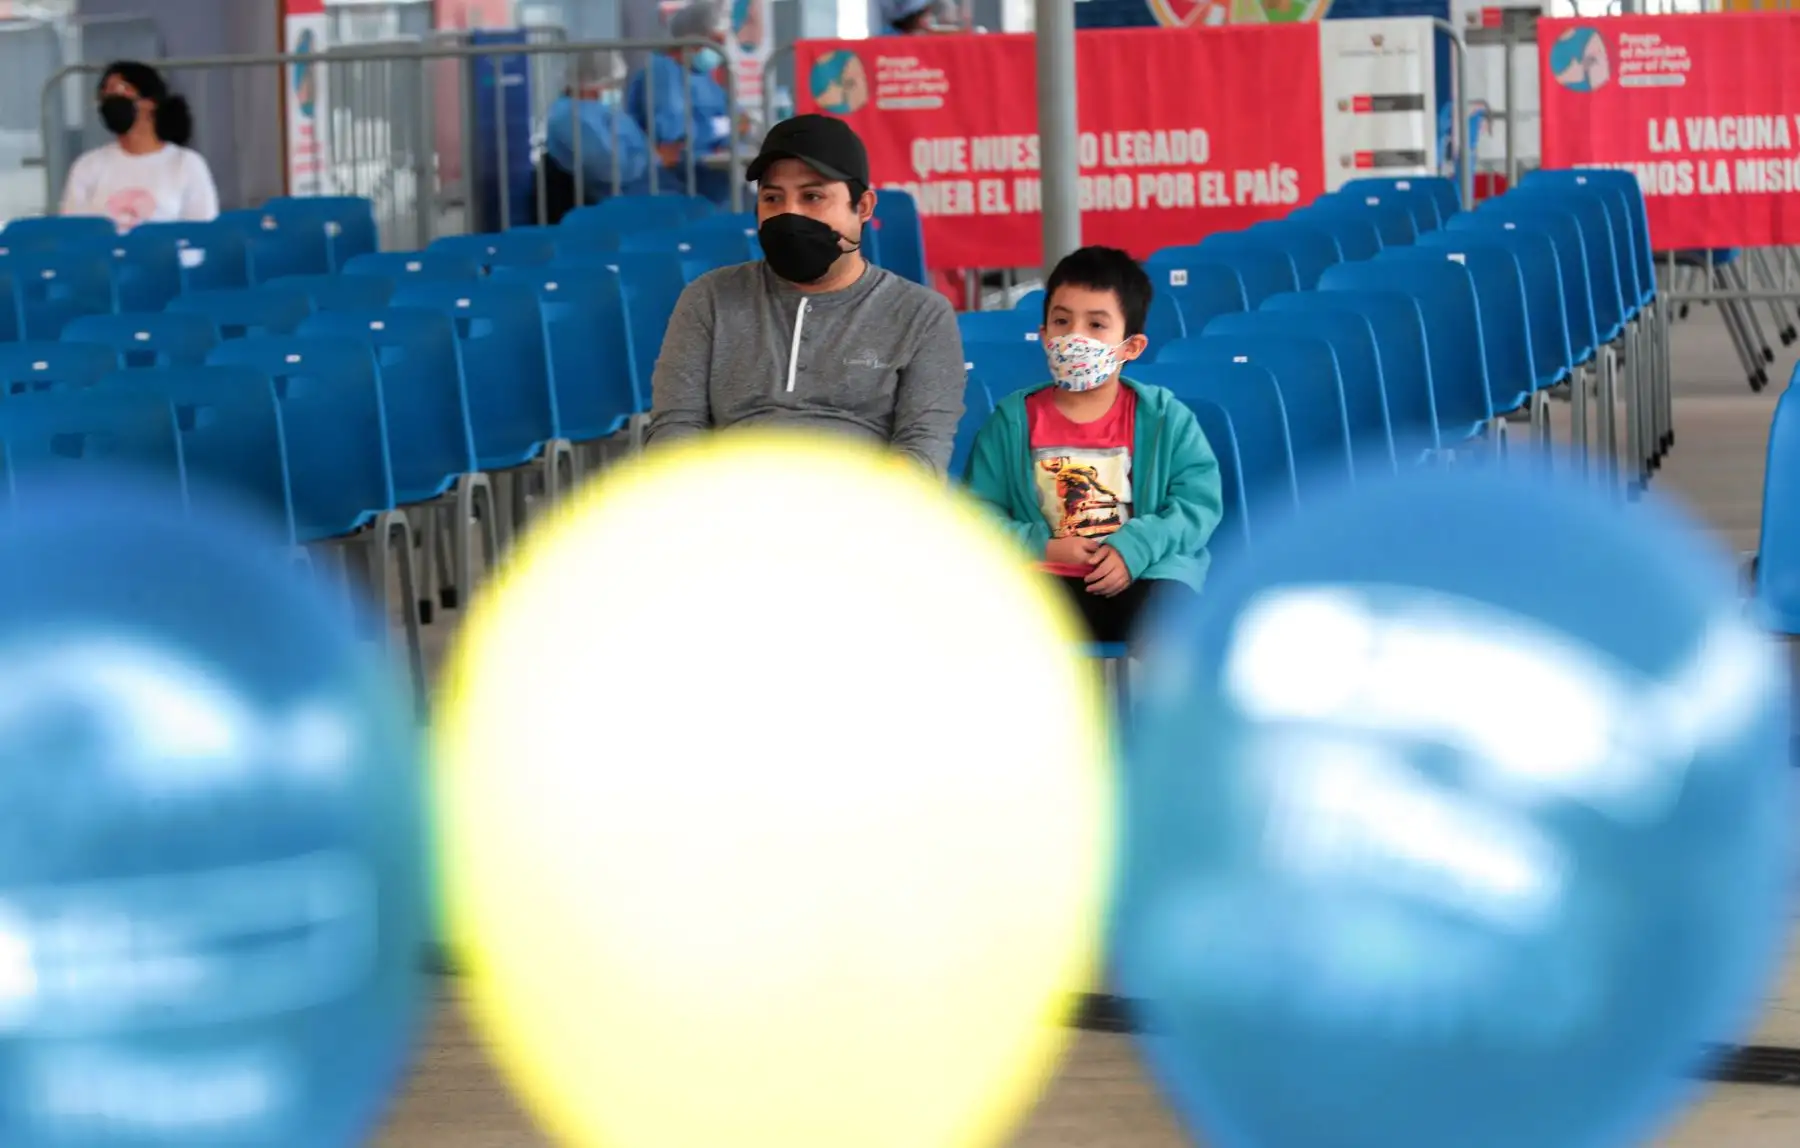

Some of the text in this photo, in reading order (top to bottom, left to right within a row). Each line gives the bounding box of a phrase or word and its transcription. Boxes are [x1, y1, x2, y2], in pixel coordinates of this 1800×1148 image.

[911, 128, 1209, 180] QUE NUESO LEGADO
[1648, 117, 1681, 152] LA
[1684, 114, 1791, 151] VACUNA
[978, 178, 1011, 214] EL
[1013, 173, 1132, 213] HBRO
[1138, 172, 1195, 209] POR
[1198, 170, 1231, 206] EL
[1235, 161, 1299, 205] PAÍS
[1698, 158, 1732, 194] LA
